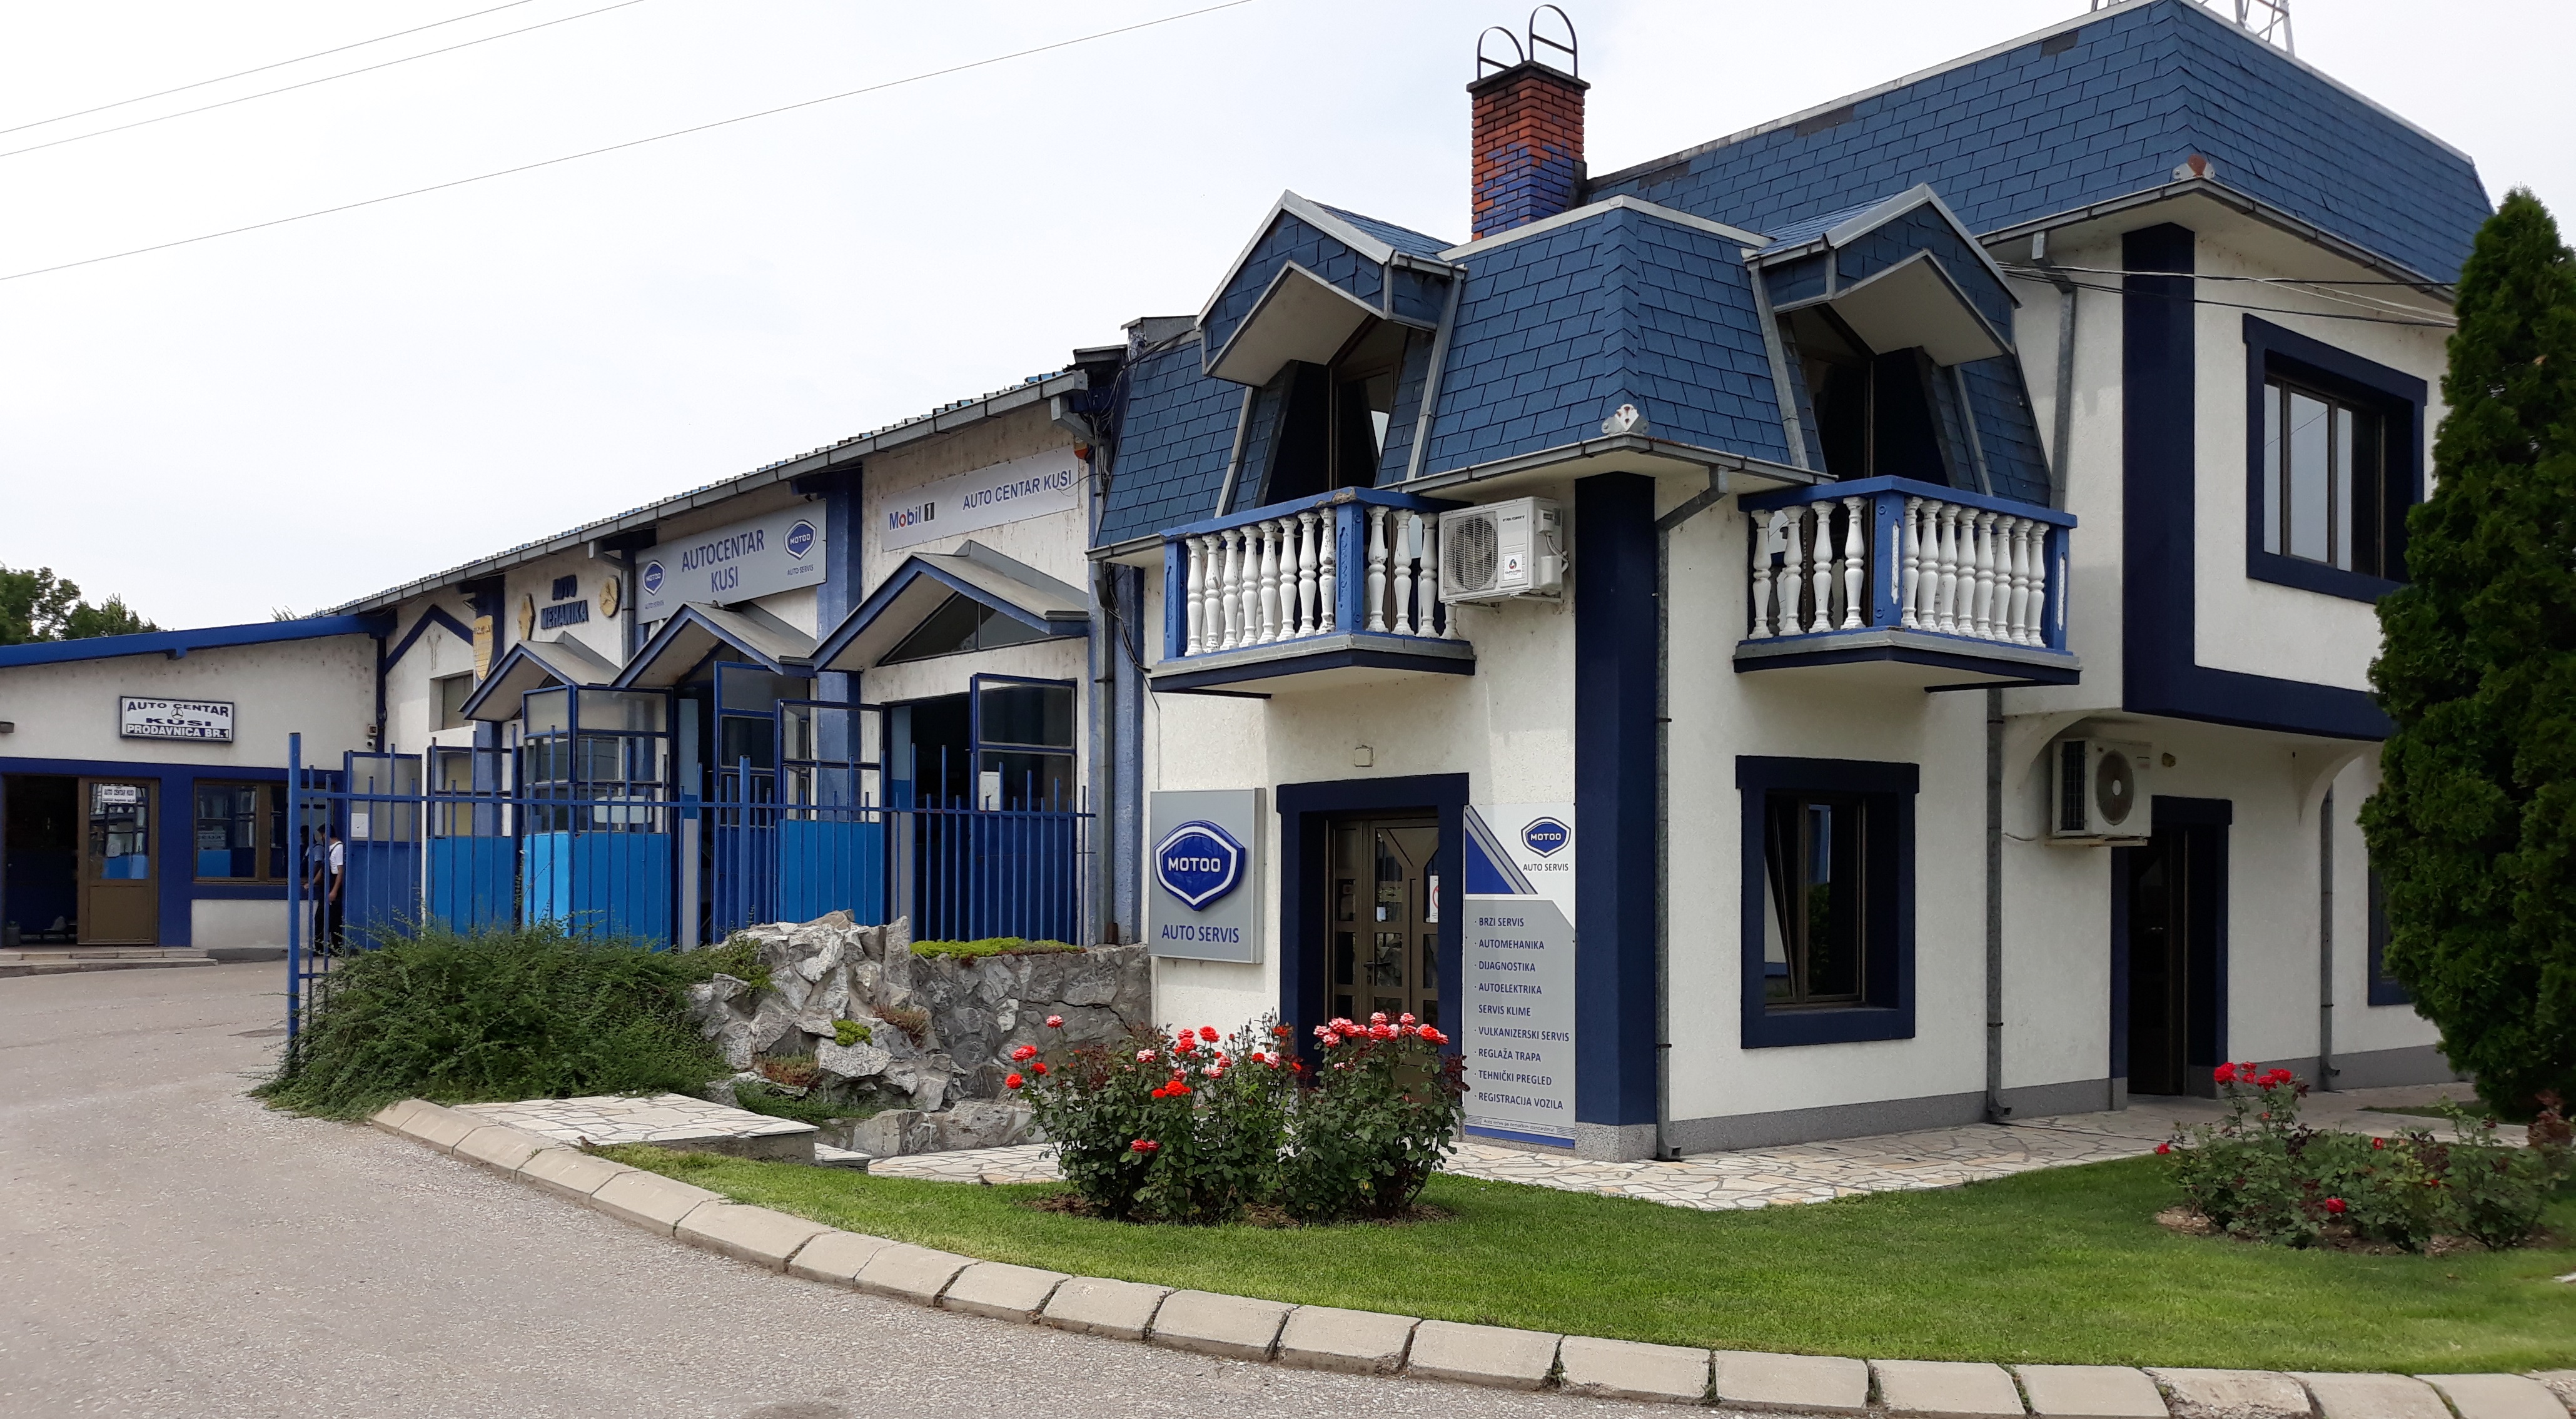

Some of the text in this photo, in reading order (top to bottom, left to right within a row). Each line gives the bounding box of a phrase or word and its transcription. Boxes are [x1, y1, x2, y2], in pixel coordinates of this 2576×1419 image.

[962, 470, 1071, 510] AUTO CENTAR KUSI
[889, 505, 921, 530] Mobil
[790, 533, 811, 545] MOTOO
[681, 529, 765, 572] AUTOCENTAR
[710, 565, 739, 593] KUSI
[127, 701, 229, 717] AUTO CENTAR
[146, 717, 211, 727] KUSI
[127, 724, 229, 738] PRODAVNICA BR.1
[1168, 857, 1221, 872] MOTOO
[1523, 863, 1568, 871] AUTO SERVIS
[1478, 917, 1524, 927] BRZI SERVIS
[1161, 924, 1240, 943] AUTO SERVIS
[1478, 939, 1545, 949] AUTOMEHANIKA
[1478, 961, 1535, 972] DIJAGNOSTIKA
[1478, 982, 1542, 994] AUTOELEKTRIKA
[1478, 1004, 1531, 1016] SERVIS KLIME
[1478, 1026, 1569, 1041] VULKANIZERSKI SERVIS
[1478, 1048, 1541, 1062] REGLAŽA TRAPA
[1478, 1070, 1552, 1085] TEHNIČKI PREGLED
[1478, 1092, 1563, 1109] REGISTRACIJA VOZILA
